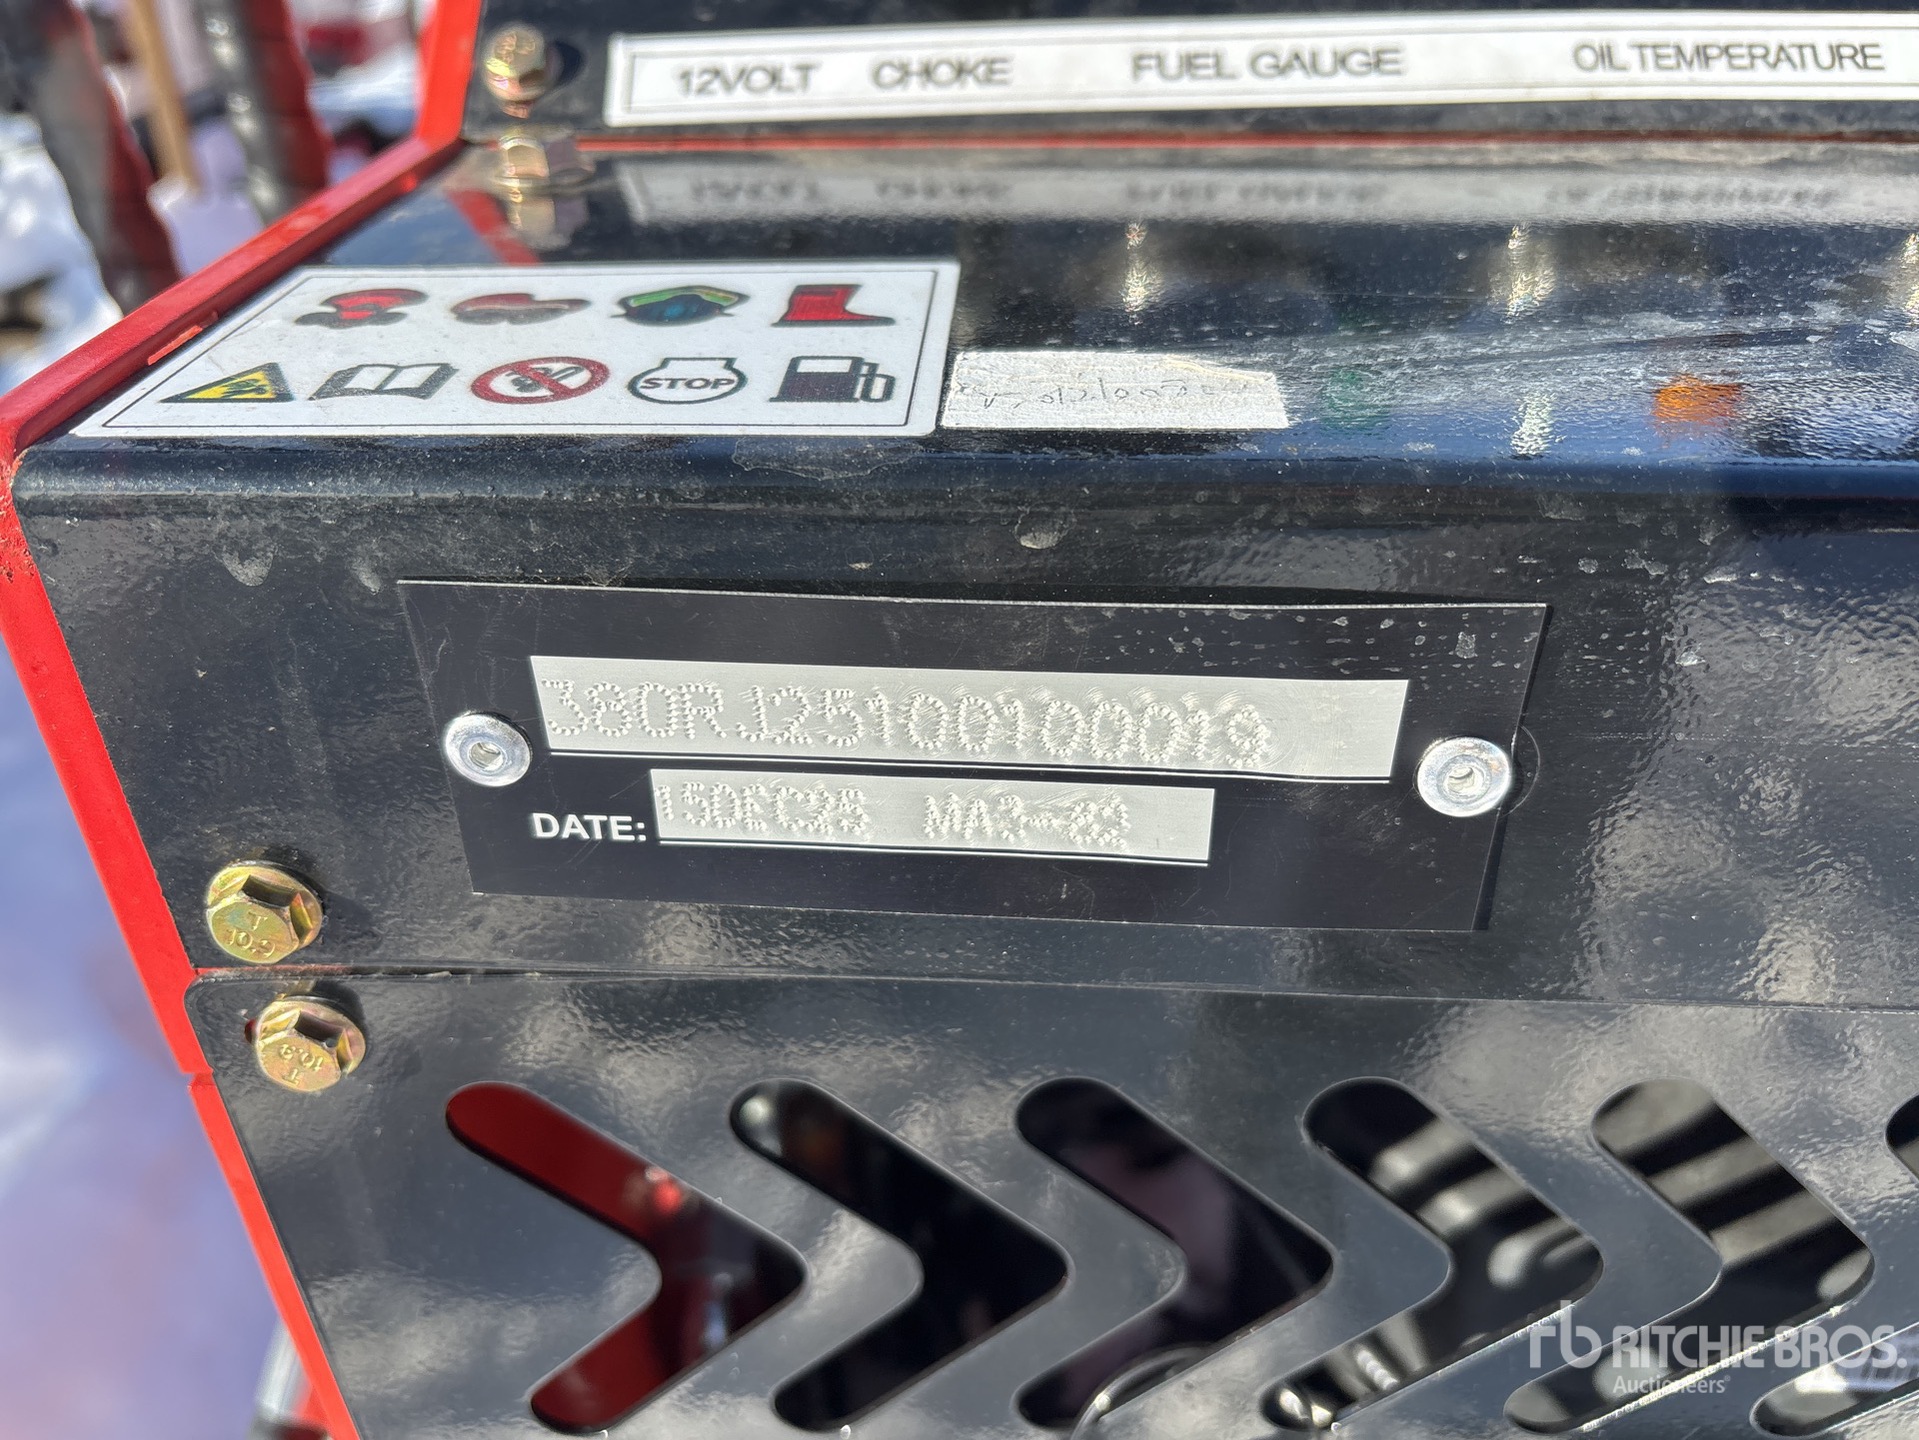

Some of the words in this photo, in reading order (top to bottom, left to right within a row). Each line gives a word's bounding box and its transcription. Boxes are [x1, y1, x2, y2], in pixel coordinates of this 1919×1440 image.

[1132, 51, 1239, 81] FUEL
[1251, 46, 1404, 77] GAUGE
[1571, 43, 1628, 72] OIL
[1630, 42, 1886, 72] TEMPERATURE
[679, 63, 820, 97] 12VOLT
[873, 57, 1014, 89] CHOKE
[640, 377, 735, 389] STOP
[531, 812, 647, 842] DATE:
